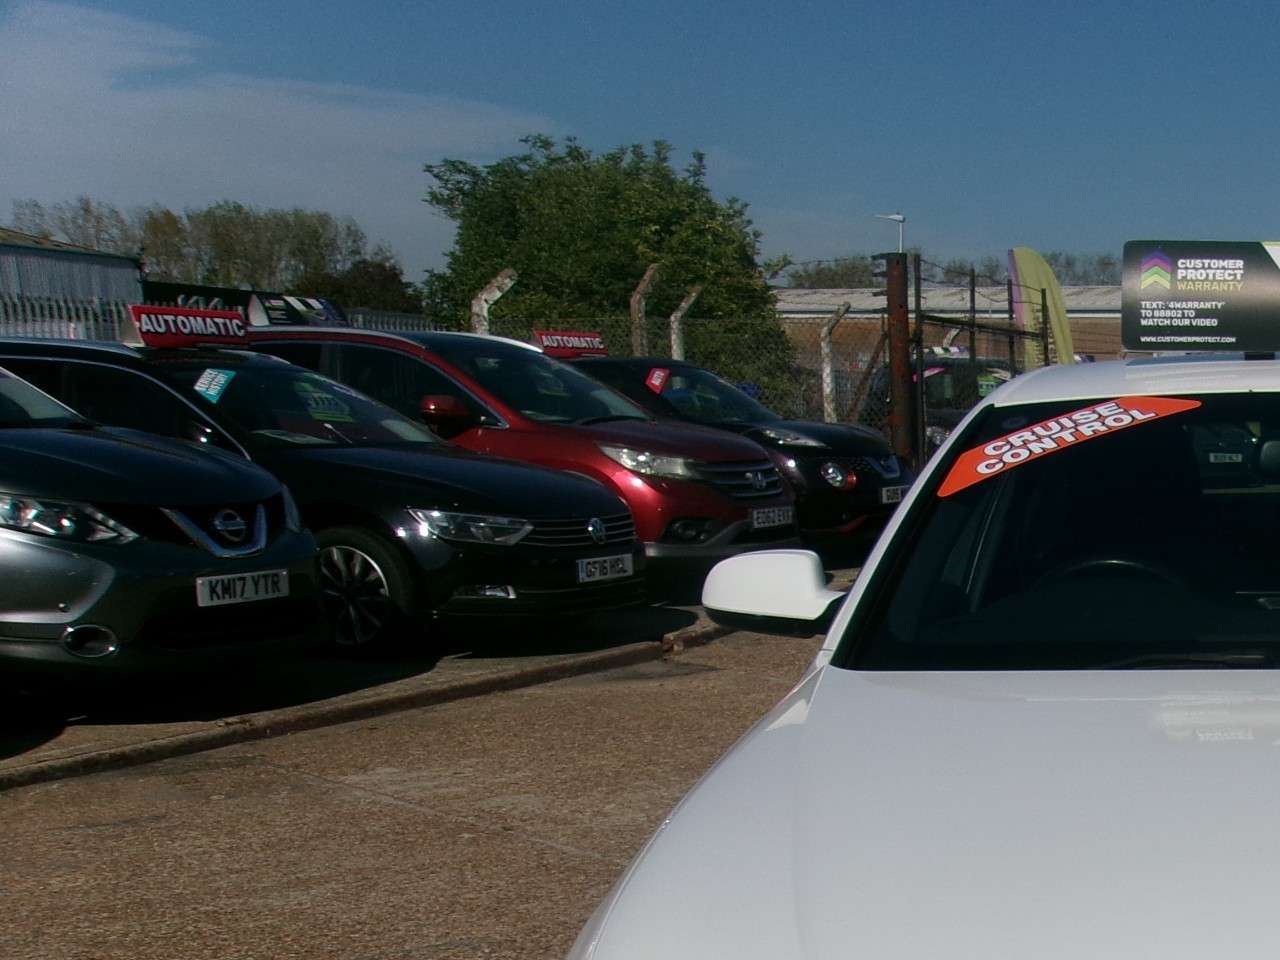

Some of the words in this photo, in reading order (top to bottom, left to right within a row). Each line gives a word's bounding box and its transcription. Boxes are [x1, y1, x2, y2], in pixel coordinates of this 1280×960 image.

[1177, 259, 1244, 269] CUSTOMER
[1177, 269, 1244, 280] PROTECT
[1177, 281, 1244, 291] WARRANTY
[1140, 301, 1165, 309] TEXT:
[1140, 310, 1152, 318] TO
[1153, 310, 1182, 318] 88802
[1183, 310, 1195, 318] TO
[140, 313, 245, 337] AUTOMATIC
[1140, 319, 1171, 327] WATCH
[1172, 319, 1191, 327] OUR
[1192, 319, 1218, 327] VIDEO
[542, 335, 605, 349] AUTOMATIC
[983, 402, 1124, 456] CRUISE
[976, 408, 1156, 474] CONTROL
[208, 576, 247, 601] KM17
[251, 573, 282, 595] YTR
